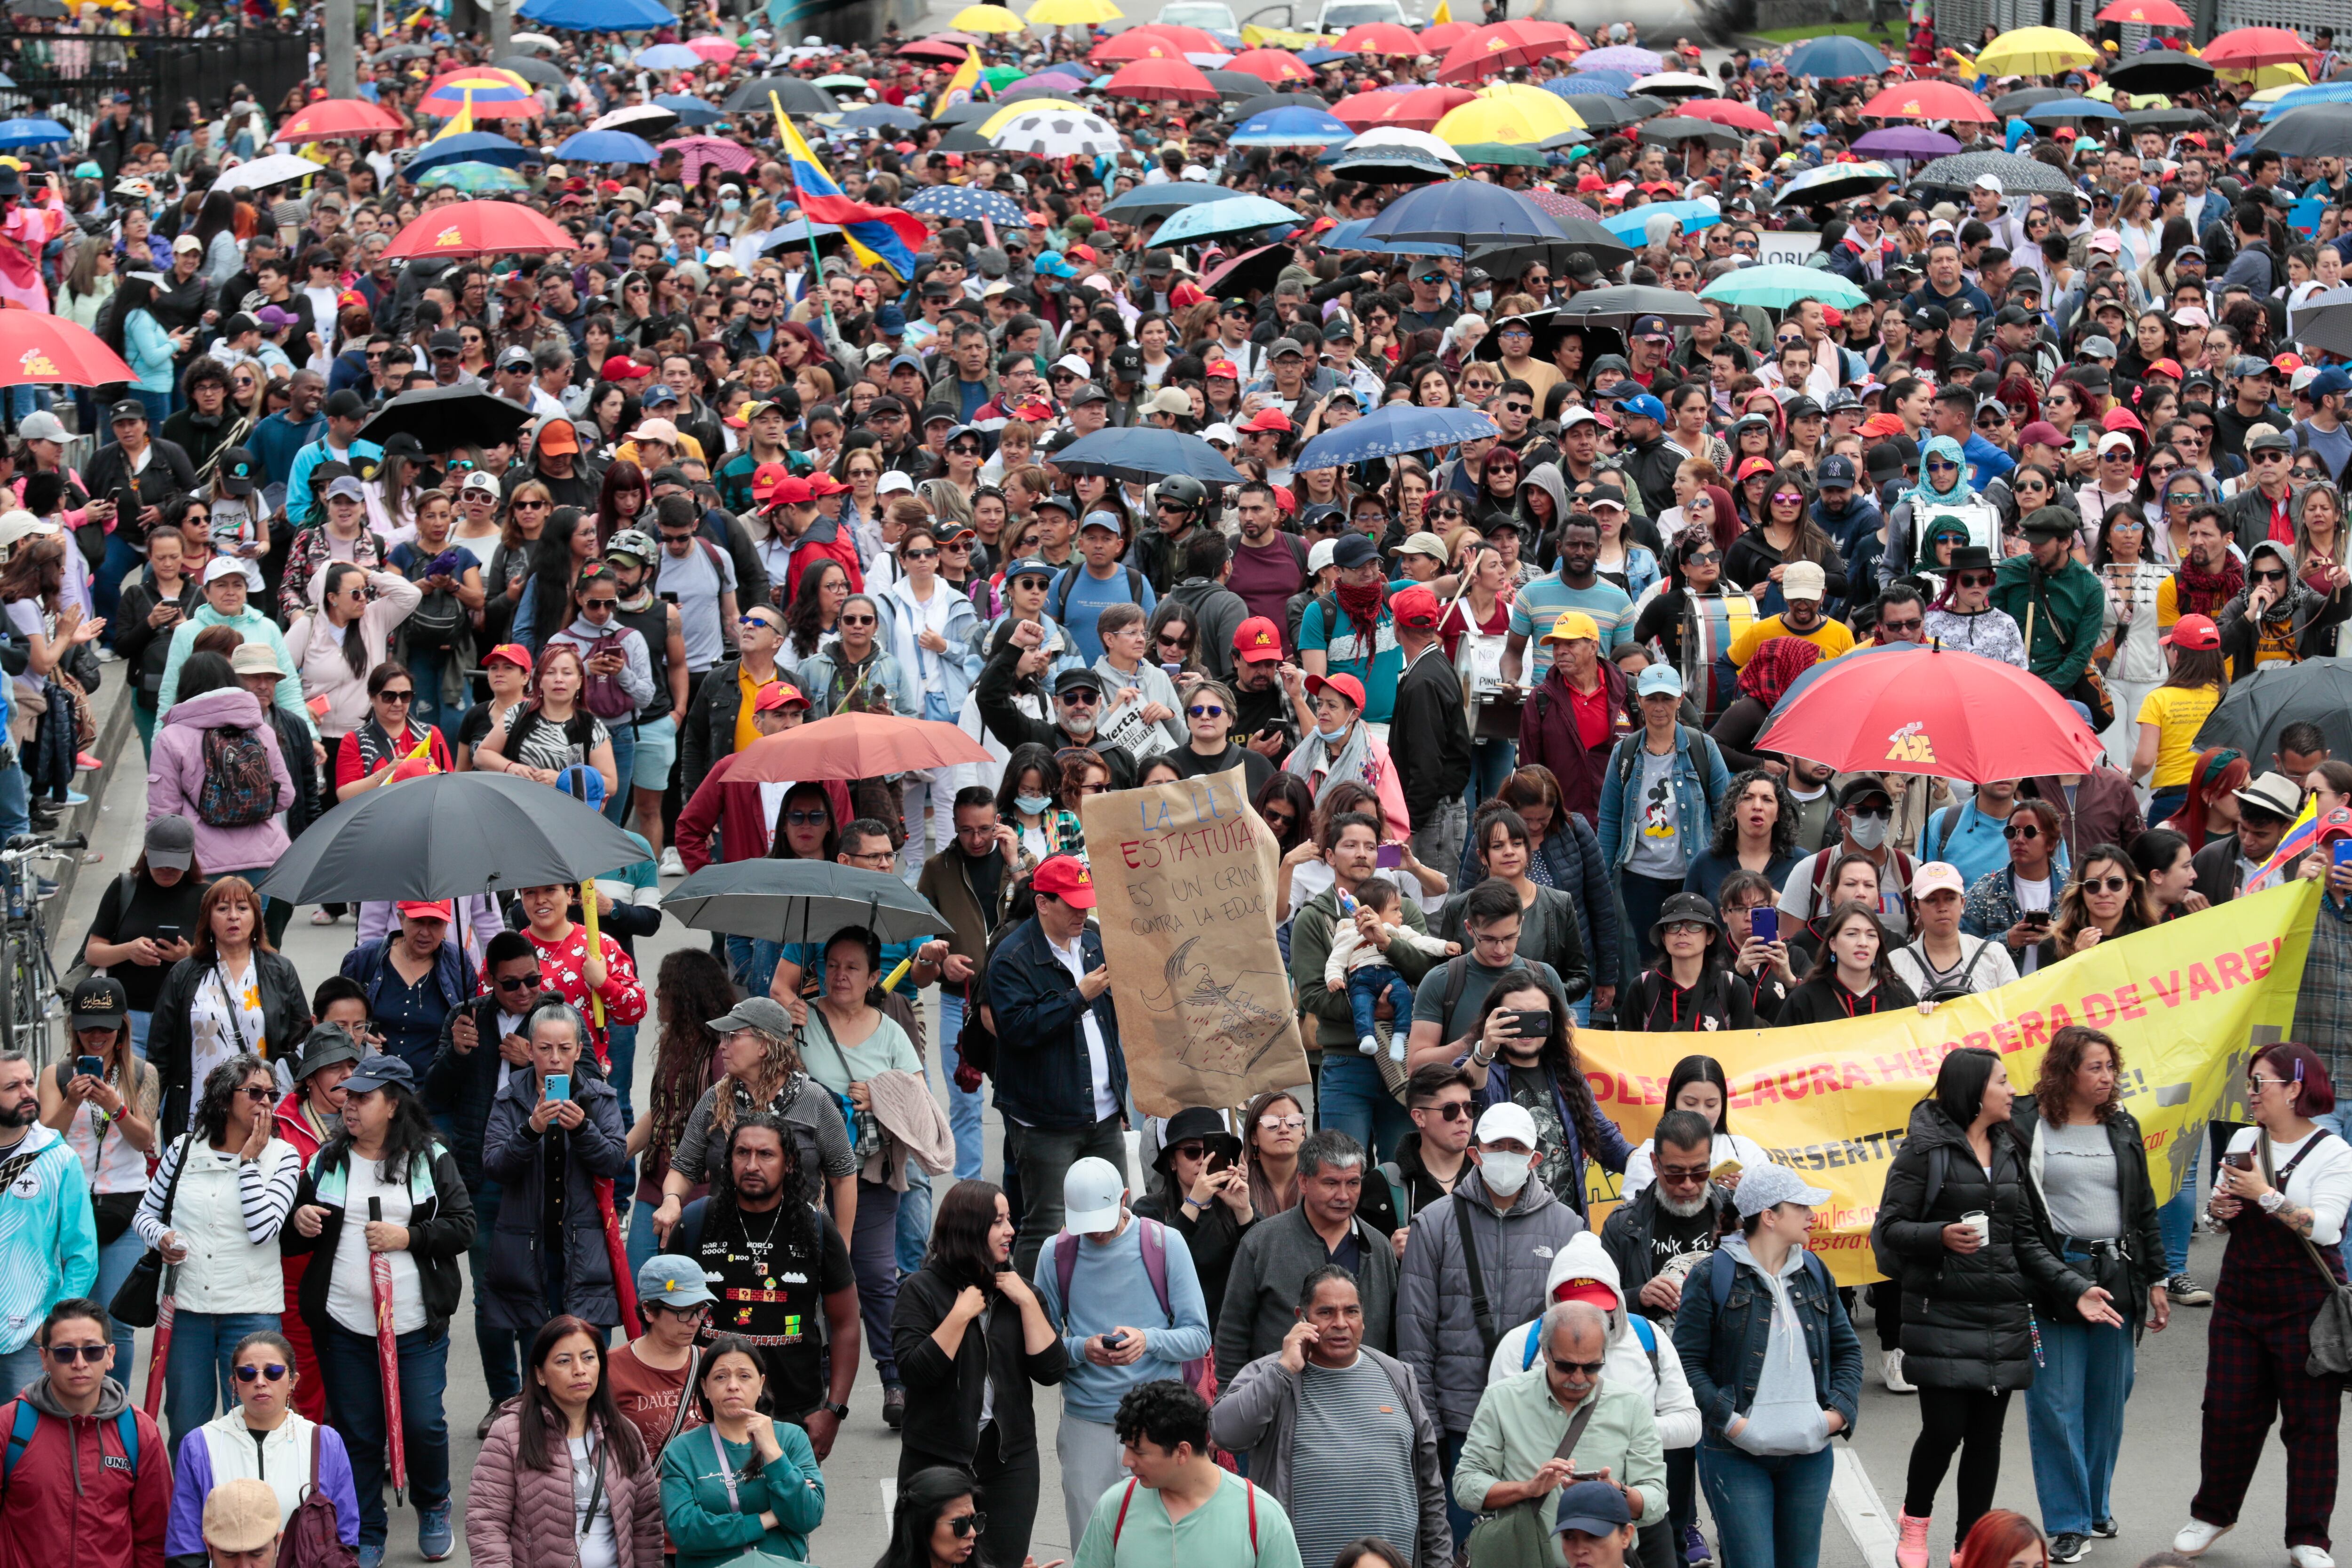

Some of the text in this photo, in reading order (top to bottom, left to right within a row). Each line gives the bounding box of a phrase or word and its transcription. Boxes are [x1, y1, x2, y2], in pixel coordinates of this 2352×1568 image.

[1884, 734, 1937, 764] ADE
[1141, 781, 1245, 831] LA LEY
[1127, 883, 1153, 906] ES
[1172, 875, 1203, 902] UN
[1131, 914, 1183, 936] CONTRA
[1193, 906, 1215, 927] LA
[1233, 990, 1282, 1022] Educación
[1584, 1072, 1668, 1106] OLE
[1725, 1062, 1871, 1109] LAURA
[2081, 983, 2148, 1029] DE
[2148, 934, 2288, 1008] VARE
[1220, 1014, 1255, 1040] Pública
